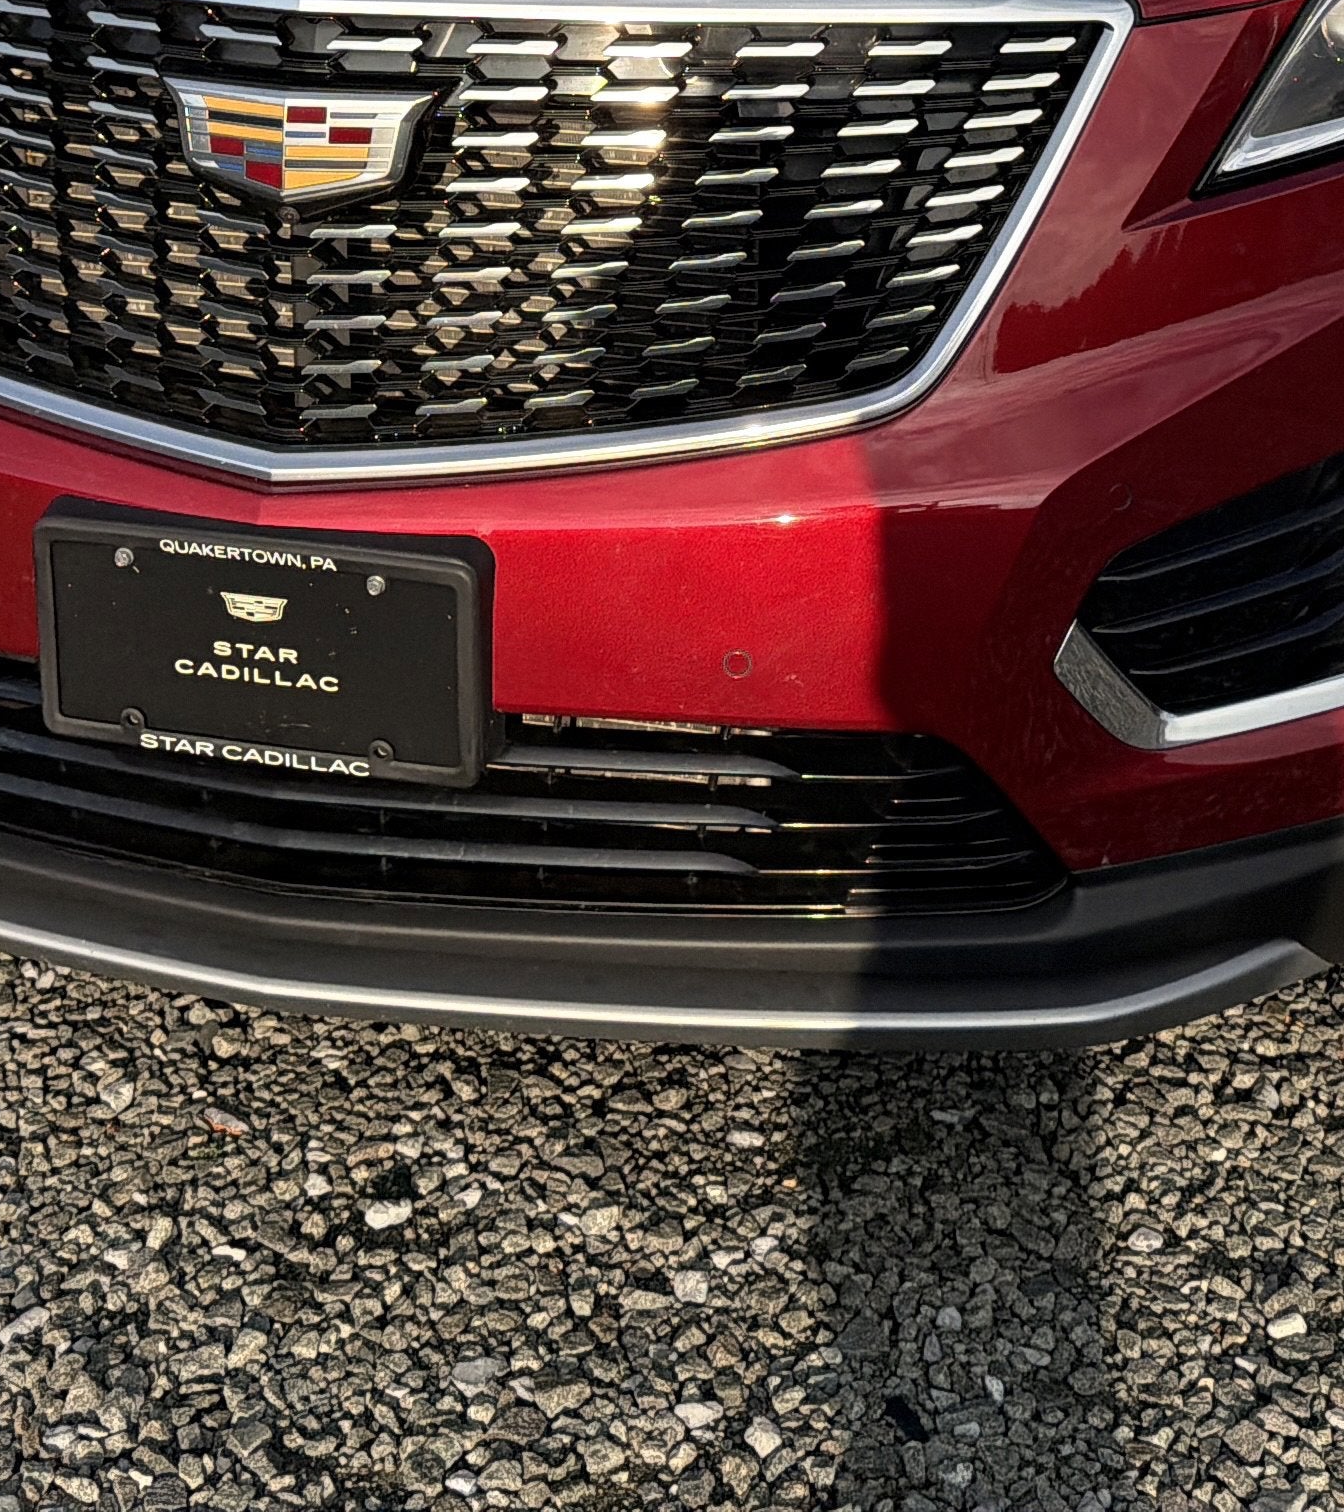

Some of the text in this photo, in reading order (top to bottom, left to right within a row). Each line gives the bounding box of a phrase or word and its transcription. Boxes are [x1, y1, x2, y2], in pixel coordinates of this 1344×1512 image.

[159, 538, 338, 572] QUAKERTOWN, PA
[213, 640, 298, 665] STAR
[174, 658, 339, 693] CADILLAC
[139, 733, 370, 777] STAR CADILLAC
